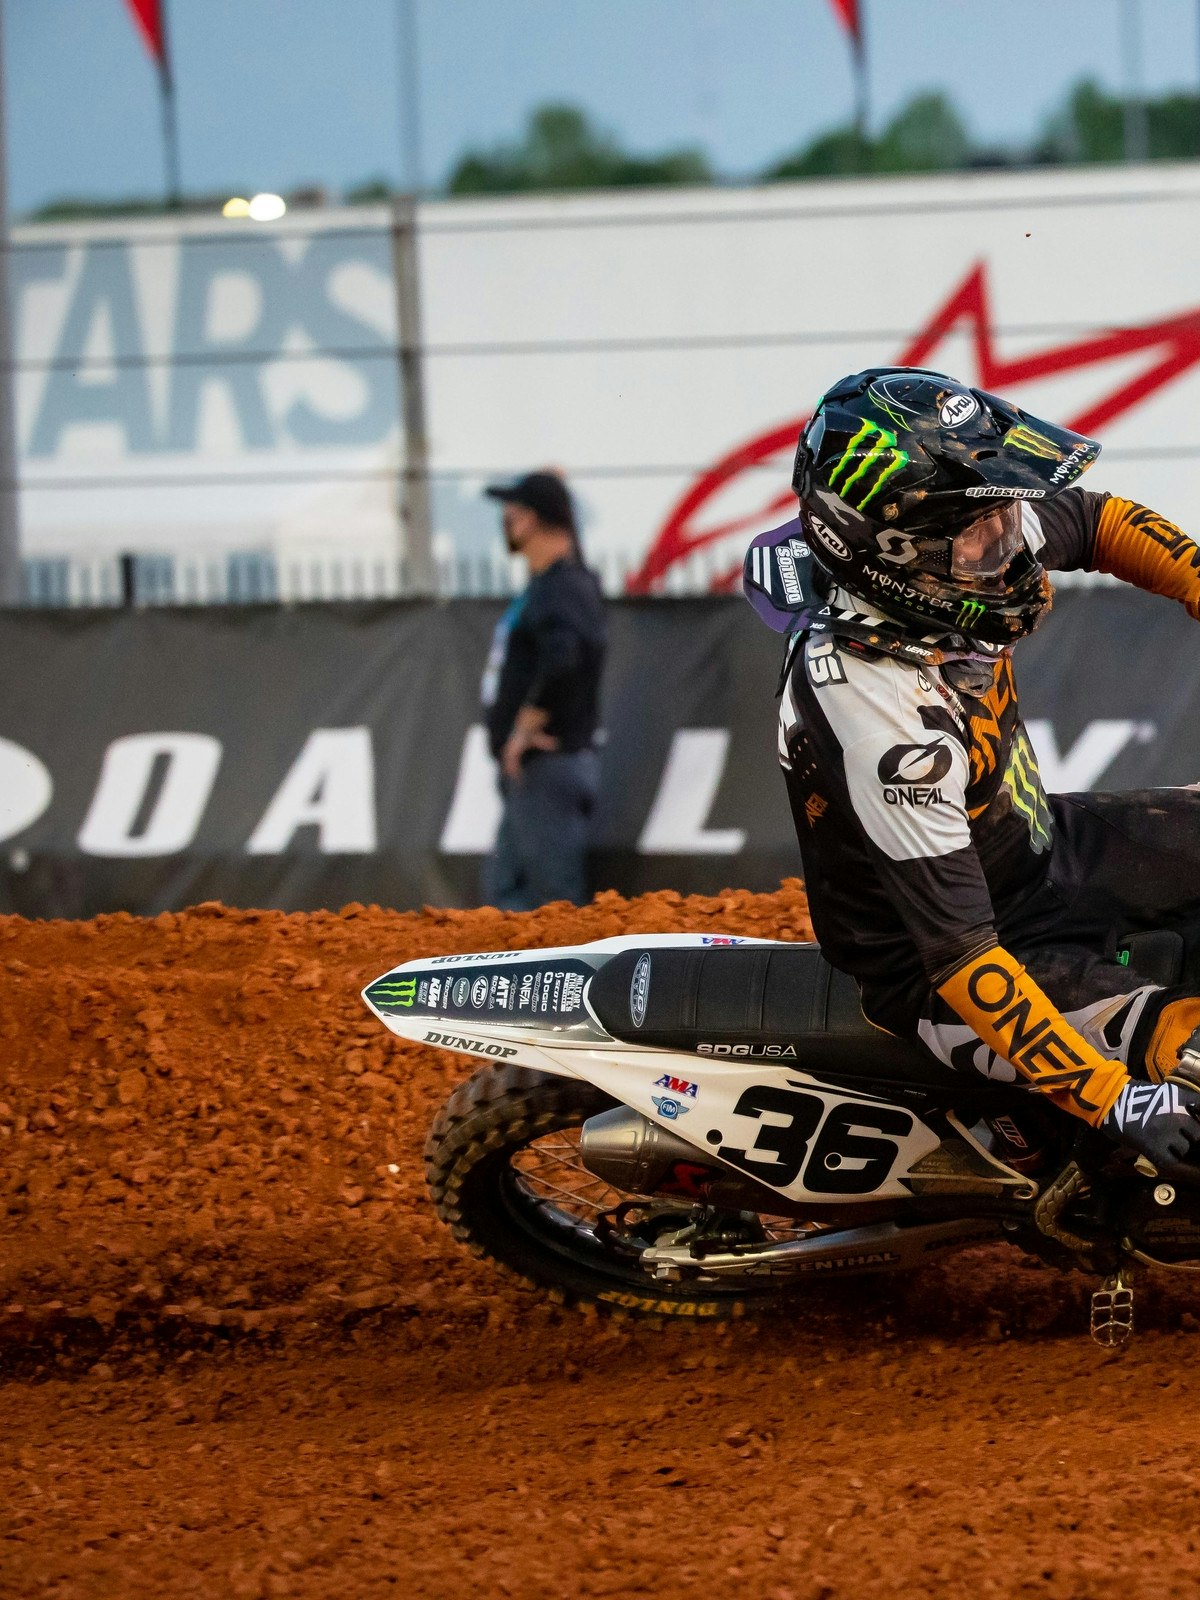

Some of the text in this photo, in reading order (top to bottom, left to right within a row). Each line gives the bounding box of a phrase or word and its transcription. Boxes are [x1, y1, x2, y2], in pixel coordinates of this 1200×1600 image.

[1050, 443, 1095, 485] MONSTER
[789, 539, 812, 558] 37
[810, 514, 849, 559] Arai
[776, 546, 803, 604] DAVALOS
[862, 565, 955, 612] MONSTER
[872, 583, 938, 615] ENERGY
[427, 977, 441, 1008] KTM
[472, 978, 486, 1005] Arai
[496, 976, 510, 1008] MTF
[541, 985, 550, 1012] OGIO
[552, 979, 561, 1012] SCOTT
[565, 972, 578, 1012] ATHLETES
[573, 974, 585, 1008] MILITARY
[423, 1031, 518, 1058] DUNLOP
[652, 1074, 699, 1098] AMA
[662, 1103, 676, 1114] FIM
[1104, 1081, 1196, 1133] NEAL
[718, 1084, 913, 1195] 36
